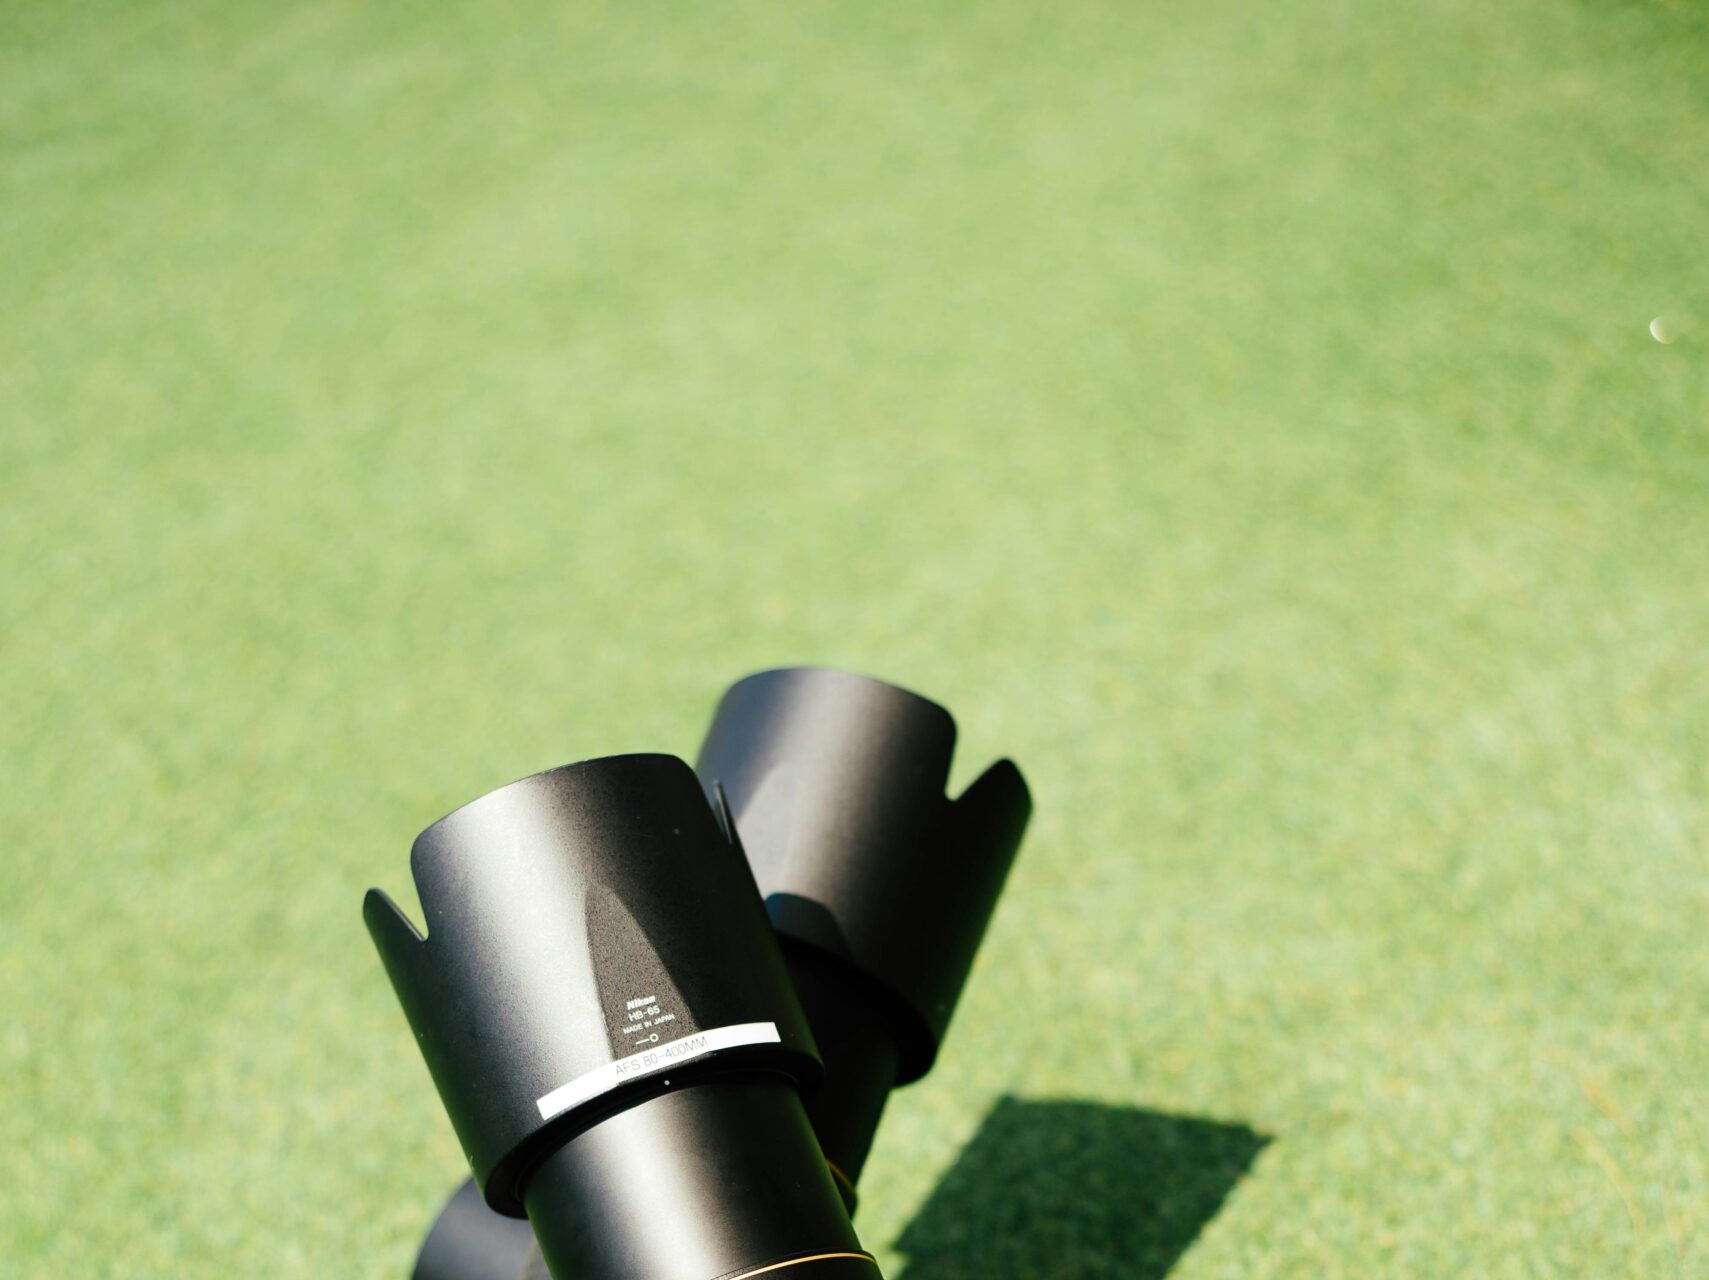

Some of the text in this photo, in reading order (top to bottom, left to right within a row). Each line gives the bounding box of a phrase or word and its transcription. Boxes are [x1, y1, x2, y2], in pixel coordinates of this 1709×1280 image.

[626, 995, 656, 1010] Nikon
[628, 1005, 660, 1022] HB-65
[623, 1013, 675, 1034] MADE IN JAPAN
[616, 1036, 708, 1076] AFS 80-400MM
